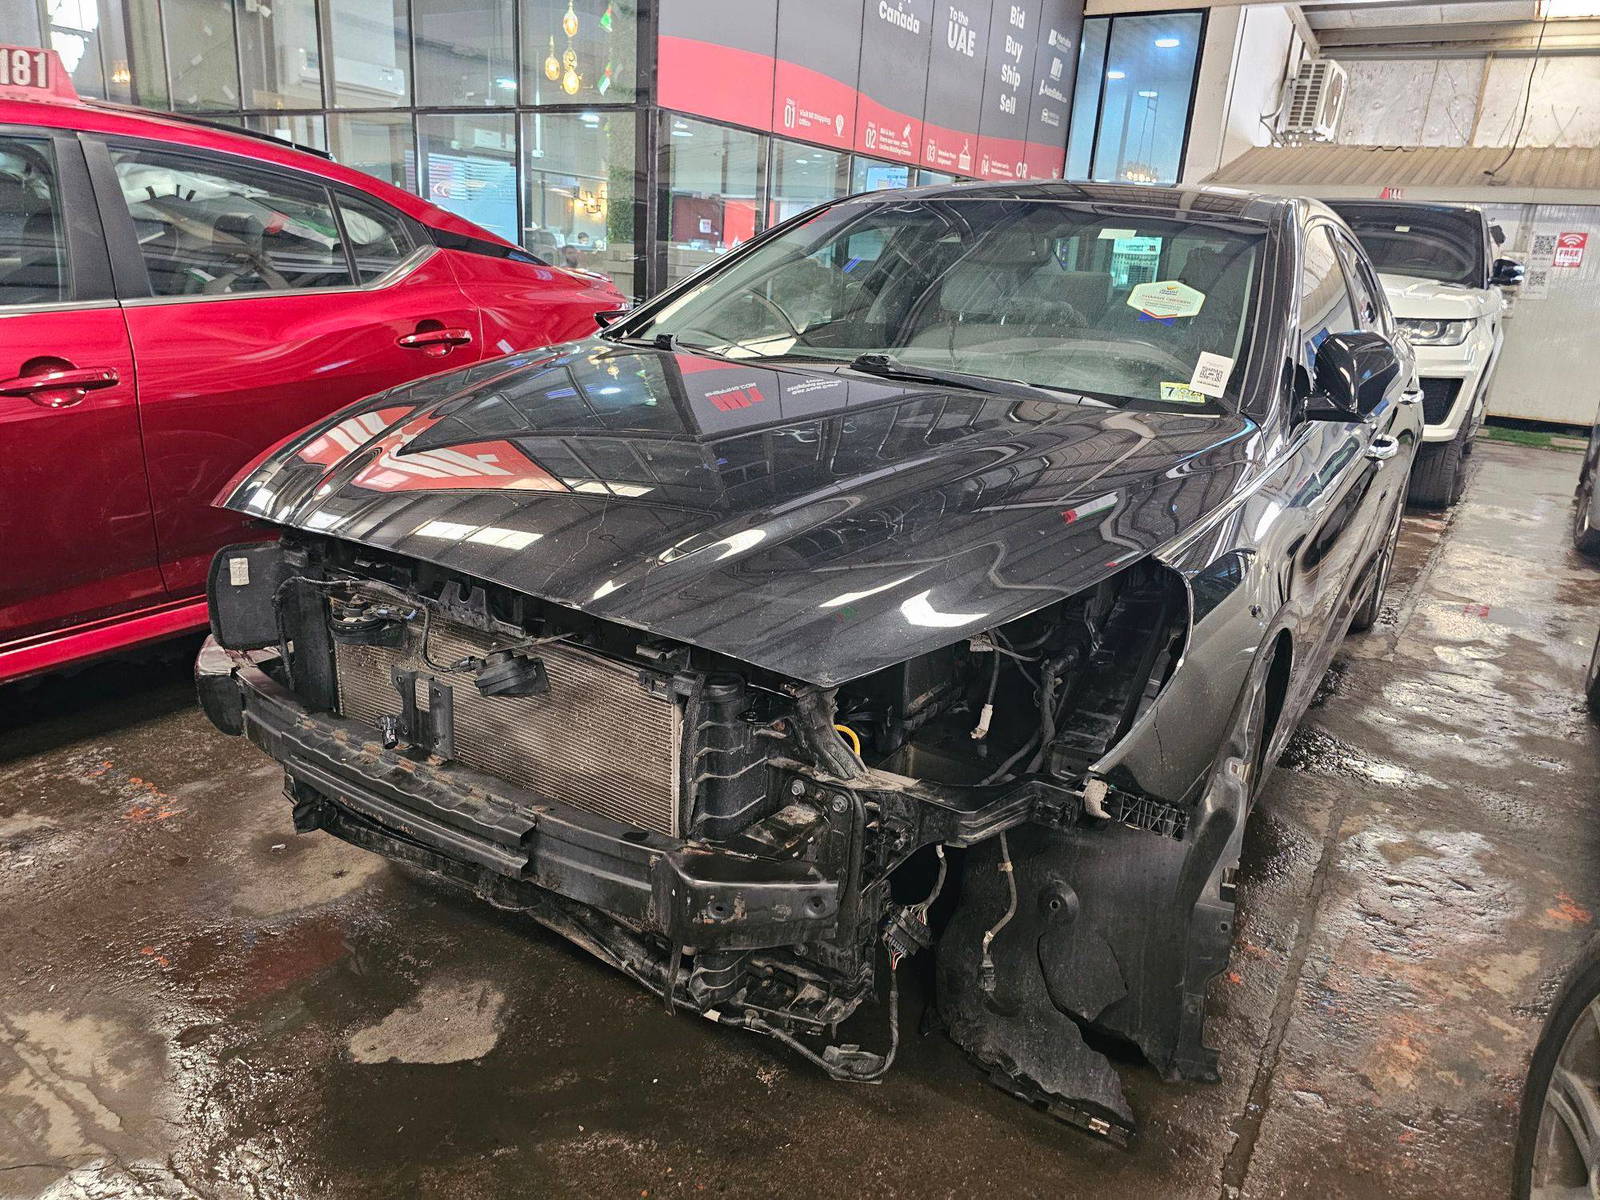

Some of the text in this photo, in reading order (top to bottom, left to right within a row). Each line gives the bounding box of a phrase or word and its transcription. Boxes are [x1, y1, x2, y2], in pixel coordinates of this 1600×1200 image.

[879, 0, 921, 35] Canada
[949, 6, 969, 27] To the
[1009, 5, 1026, 30] Bid
[947, 20, 977, 58] UAE
[1005, 34, 1024, 64] Buy
[0, 48, 47, 88] 181
[1000, 63, 1021, 92] Ship
[999, 93, 1017, 115] Sell
[784, 104, 796, 129] 01
[865, 127, 877, 149] 02
[926, 143, 936, 163] 03
[1015, 161, 1028, 179] OR
[1559, 249, 1580, 257] FREE
[1165, 386, 1175, 397] 7
